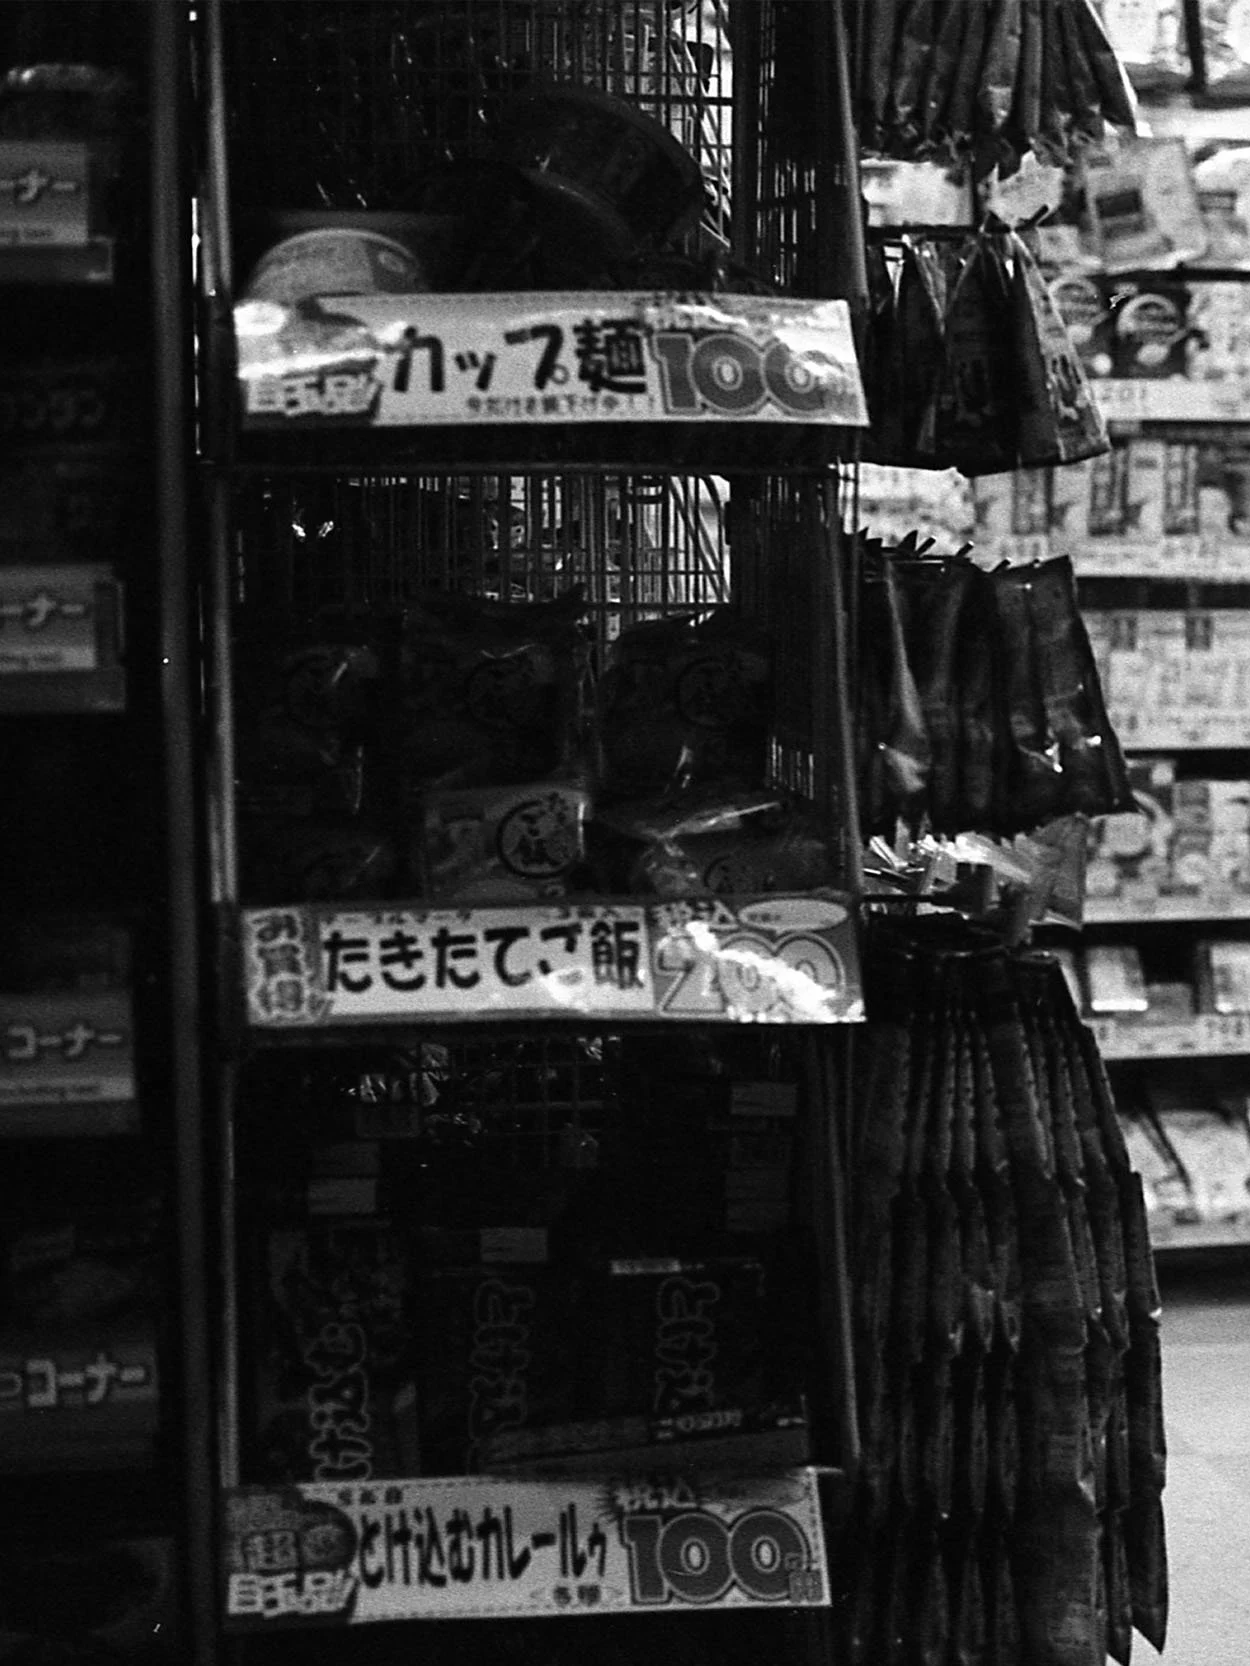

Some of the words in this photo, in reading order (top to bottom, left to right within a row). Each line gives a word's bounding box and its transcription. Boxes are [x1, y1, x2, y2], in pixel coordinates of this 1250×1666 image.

[383, 318, 648, 394] カップ麺
[7, 1022, 124, 1059] コーナー
[622, 1510, 811, 1604] 100
